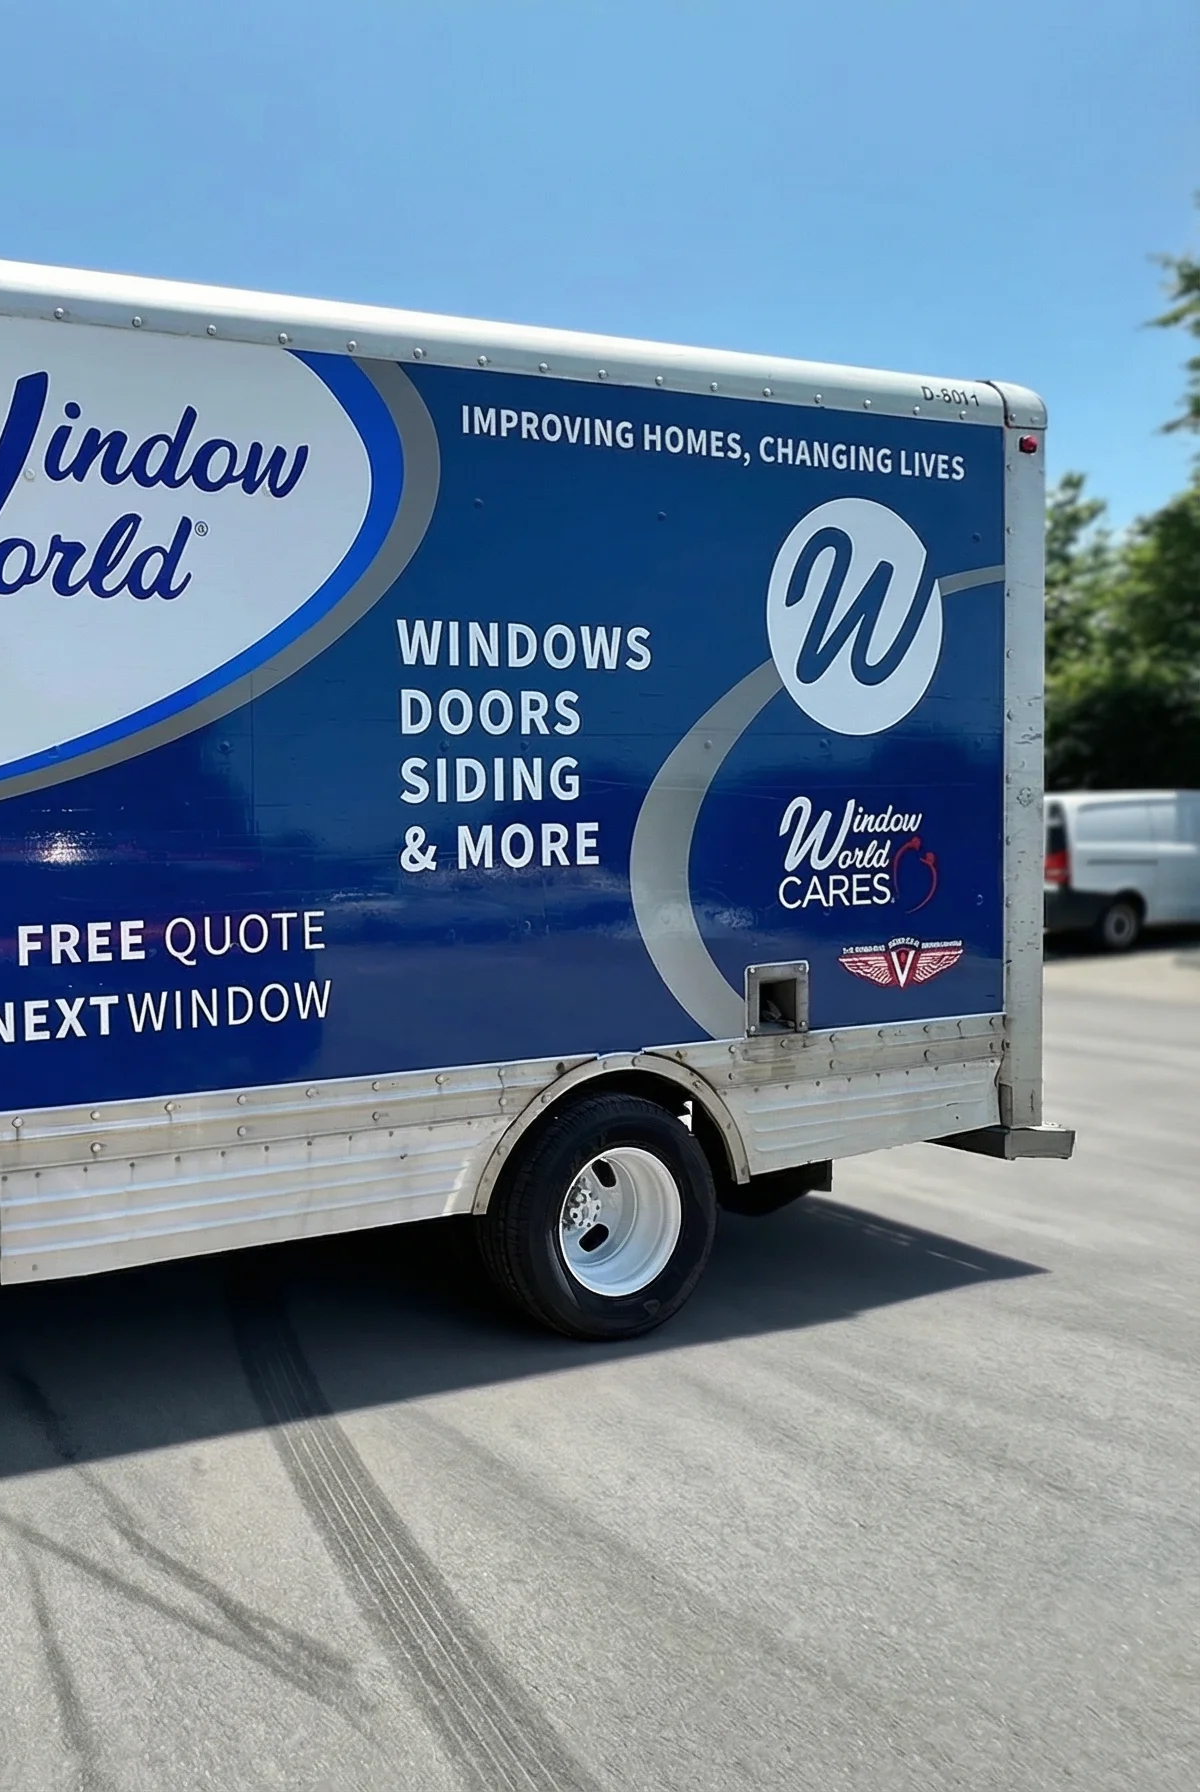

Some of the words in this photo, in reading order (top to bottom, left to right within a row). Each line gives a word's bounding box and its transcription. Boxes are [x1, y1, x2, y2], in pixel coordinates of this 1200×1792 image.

[462, 405, 634, 450] IMPROVING
[643, 424, 751, 467] HOMES,
[759, 437, 893, 475] CHANGING
[900, 450, 966, 482] LIVES
[397, 619, 652, 671] WINDOWS
[400, 688, 581, 735] DOORS
[400, 756, 580, 804] SIDING
[400, 825, 437, 873] &
[457, 822, 600, 871] MORE
[778, 873, 892, 909] CARES
[18, 920, 146, 966] FREE
[164, 911, 326, 966] QUOTE
